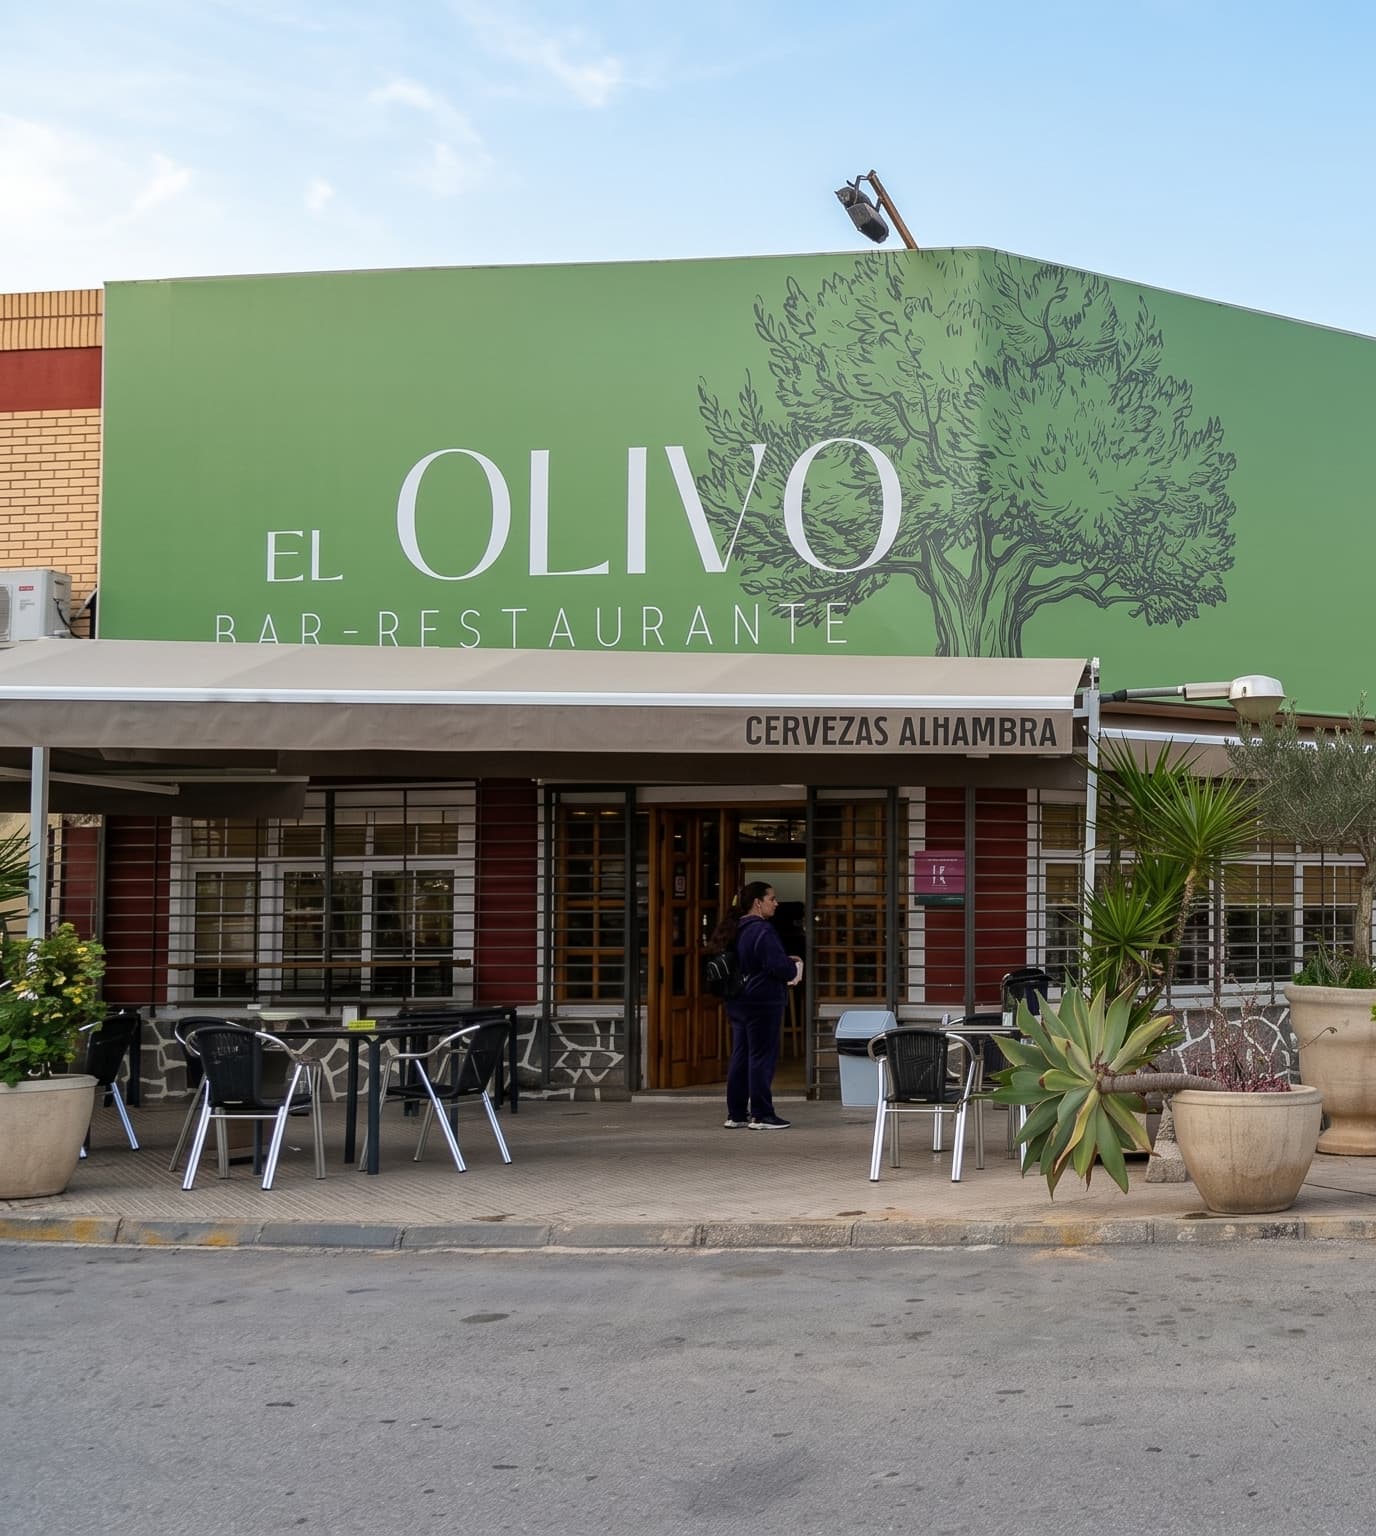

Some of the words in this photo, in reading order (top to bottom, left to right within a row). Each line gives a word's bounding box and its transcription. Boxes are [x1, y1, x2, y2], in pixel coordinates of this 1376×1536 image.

[266, 529, 344, 583] EL
[396, 437, 903, 581] OLIVO
[215, 602, 848, 649] BAR-RESTAURANTE
[745, 715, 889, 746] CERVEZAS
[898, 716, 1058, 747] ALHAMBRA
